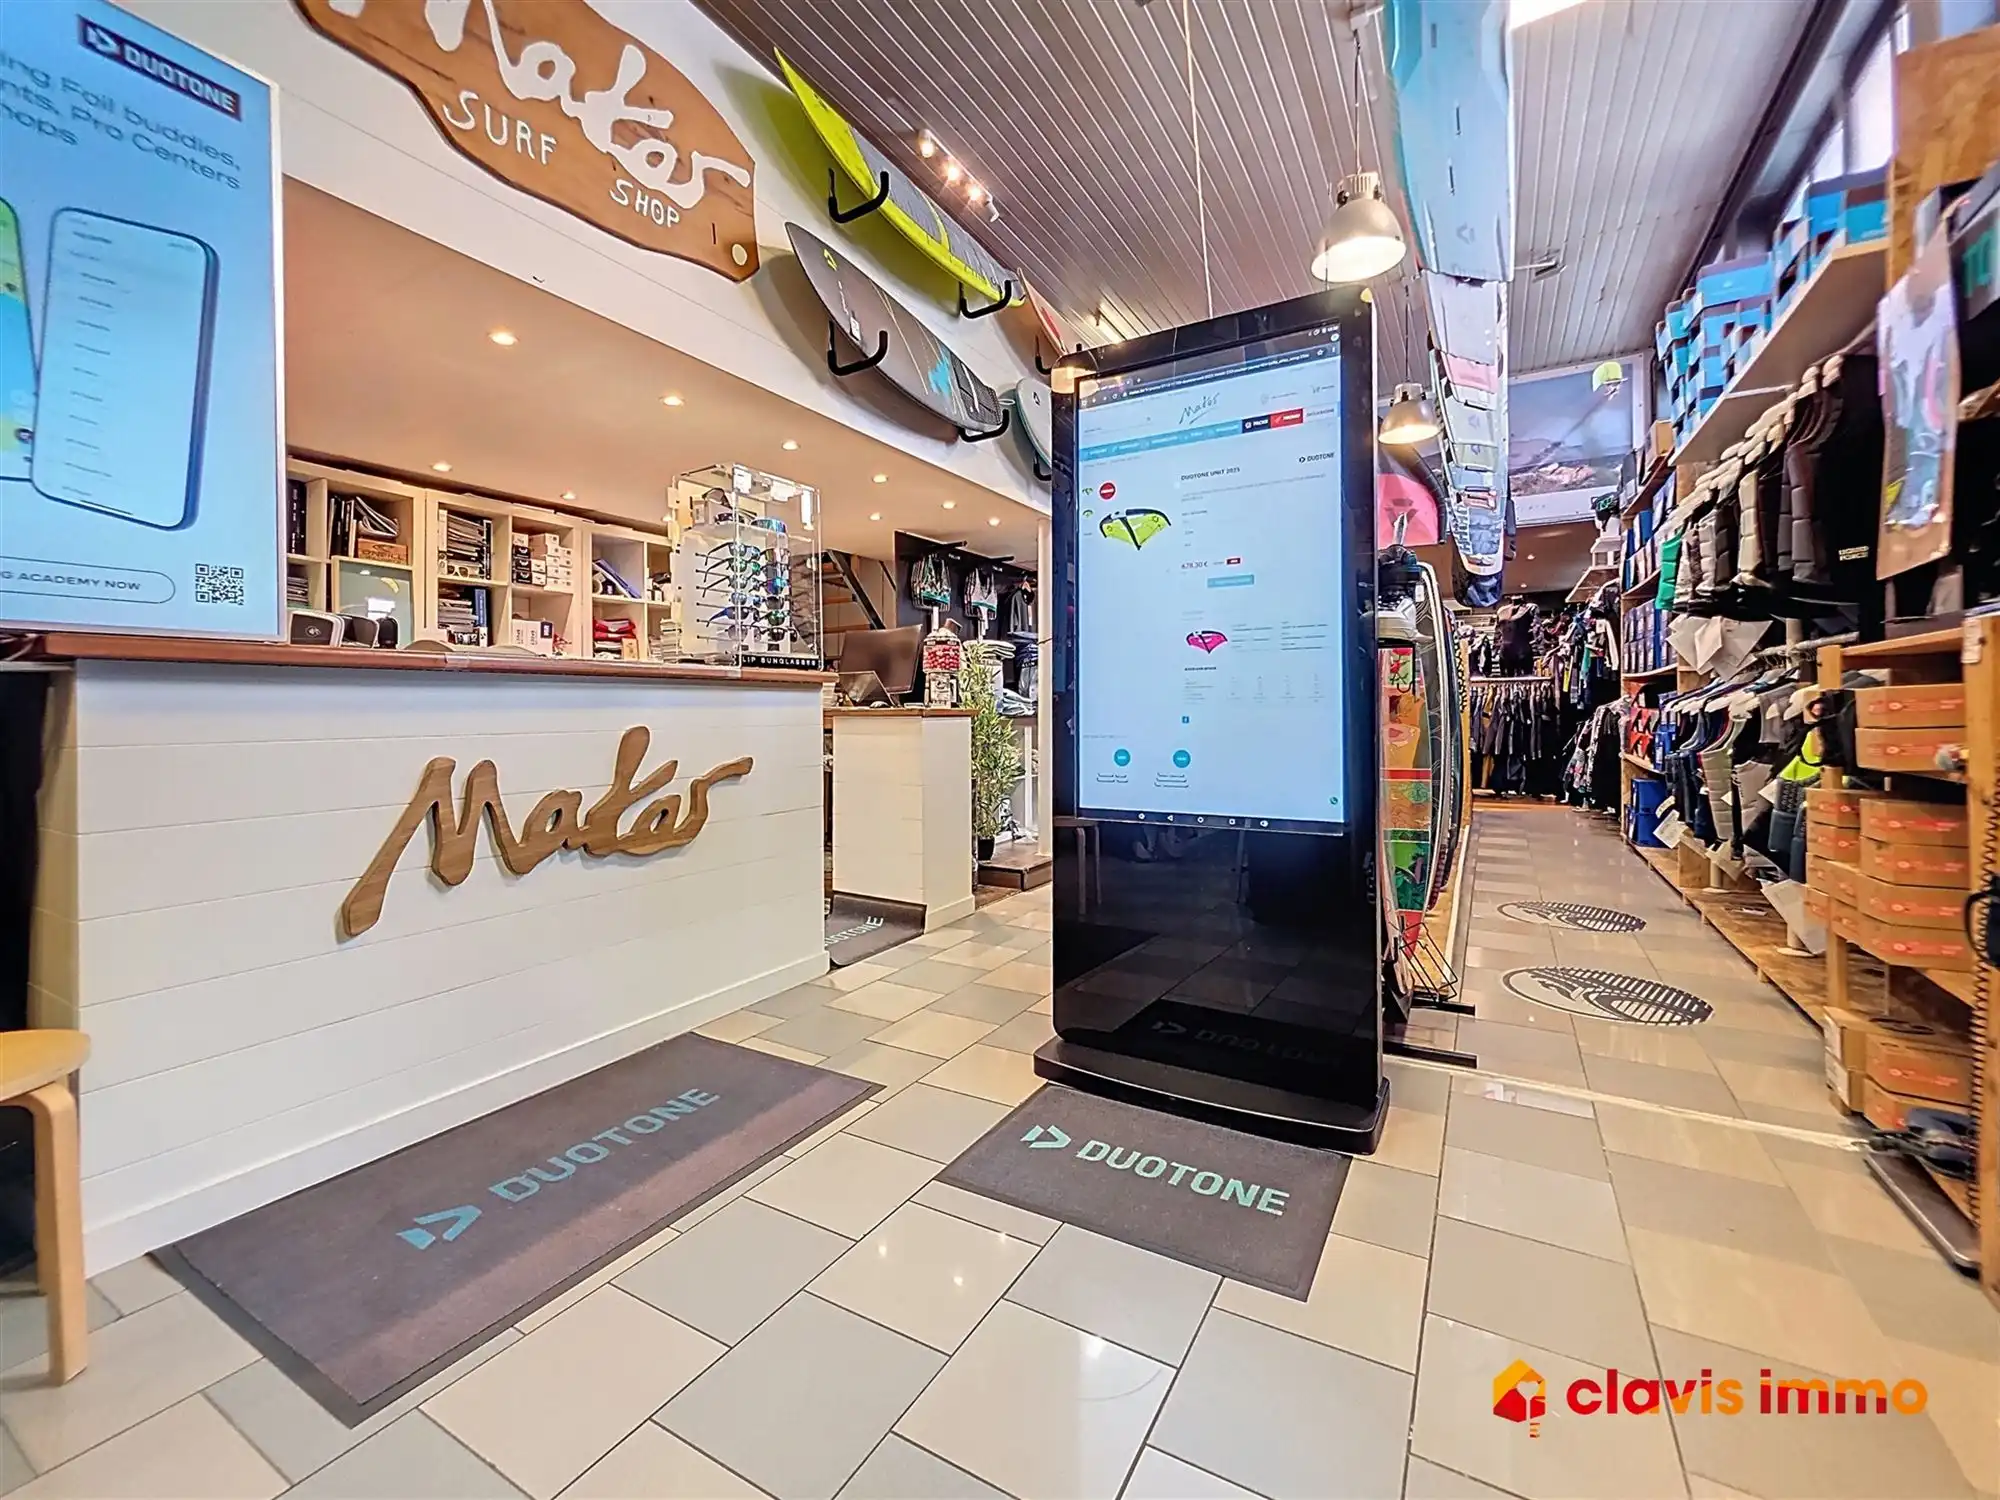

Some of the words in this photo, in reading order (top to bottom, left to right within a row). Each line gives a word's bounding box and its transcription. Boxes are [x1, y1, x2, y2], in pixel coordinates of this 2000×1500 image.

[0, 50, 51, 89] ing
[61, 77, 115, 114] Foil
[124, 45, 236, 115] DUOTONE
[71, 104, 124, 141] Pro
[132, 132, 240, 190] Centers
[442, 90, 557, 167] SURF
[609, 178, 681, 229] SHOP
[18, 572, 101, 588] ACADEMY
[104, 580, 141, 591] NOW
[488, 1088, 721, 1203] DUOTONE
[1075, 1139, 1290, 1216] DUOTONE
